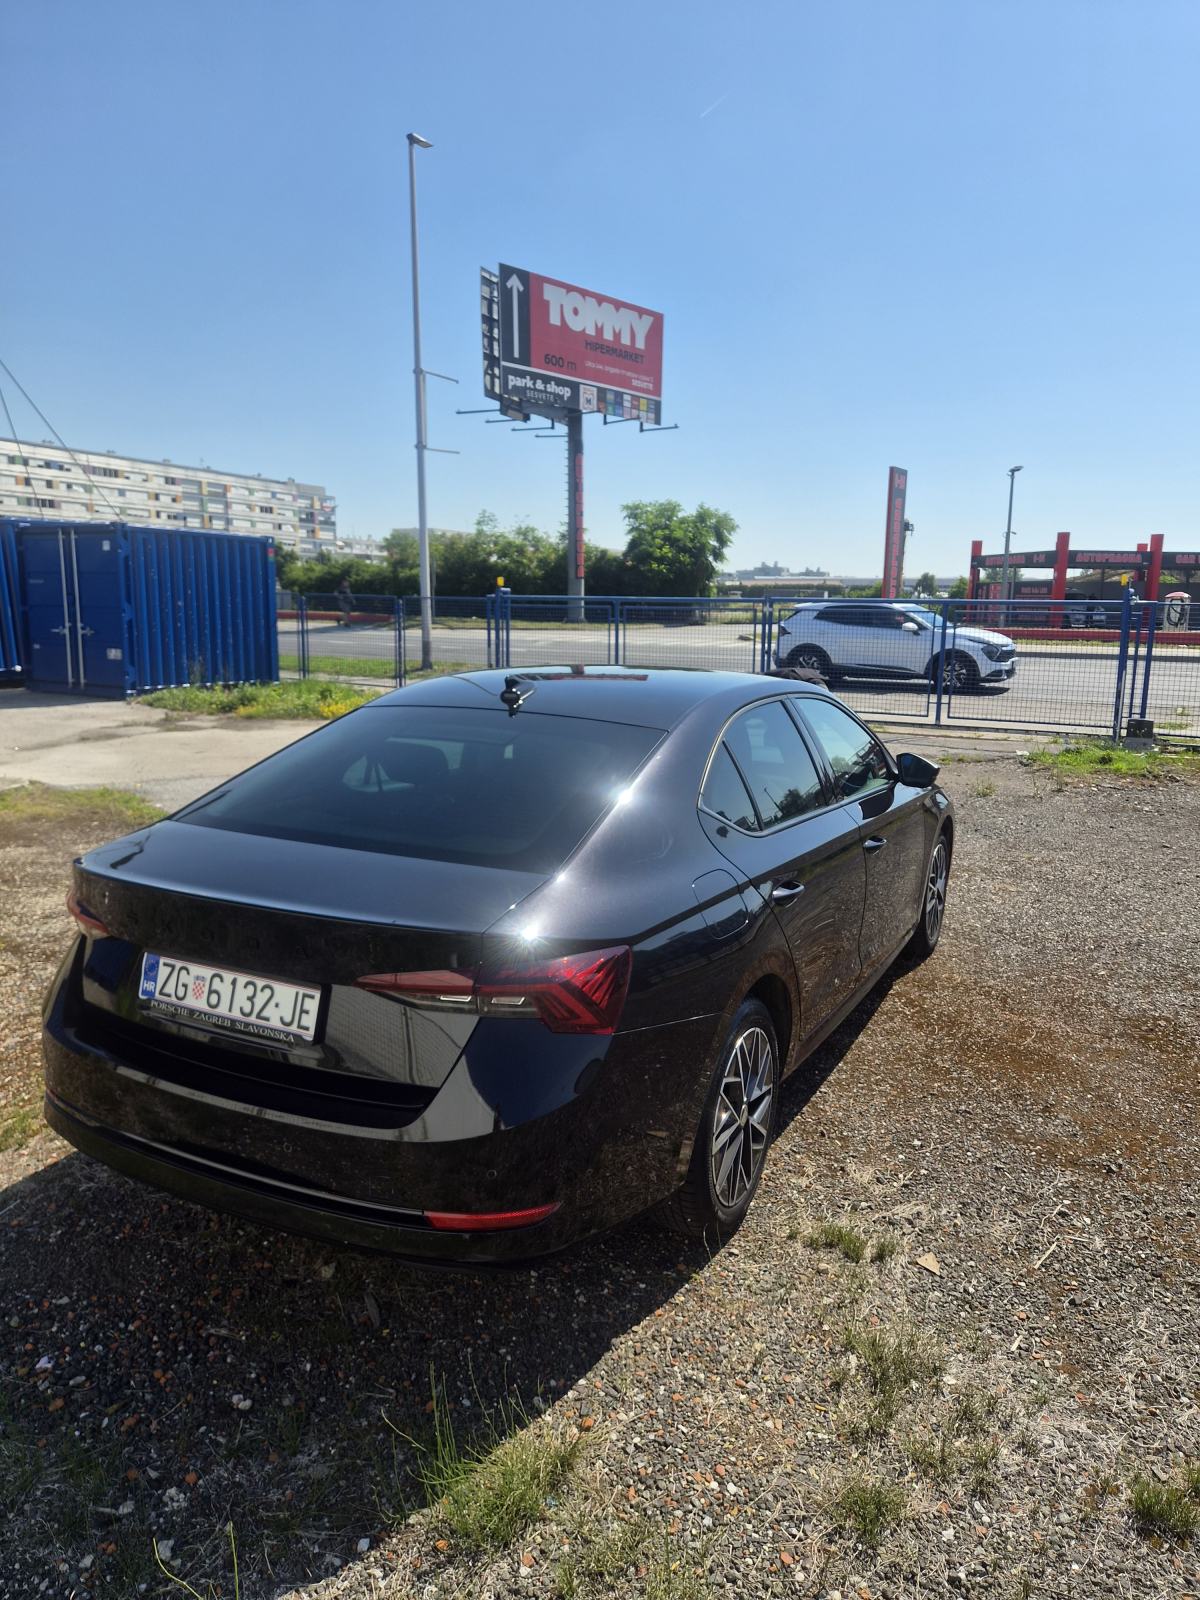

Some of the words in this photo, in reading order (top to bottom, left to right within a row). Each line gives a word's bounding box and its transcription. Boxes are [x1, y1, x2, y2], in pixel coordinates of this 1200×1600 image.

[543, 282, 654, 350] TOMMY
[544, 353, 564, 368] 600
[566, 360, 577, 371] m
[585, 340, 645, 364] HIPERMARKET
[508, 375, 534, 390] park
[535, 379, 545, 390] &
[546, 380, 572, 400] shop
[142, 981, 156, 993] HR
[158, 961, 190, 1001] ZG
[150, 1000, 190, 1017] PORSCHE
[193, 1011, 231, 1027] ZAGREB
[234, 1021, 295, 1042] SLAVONSKA
